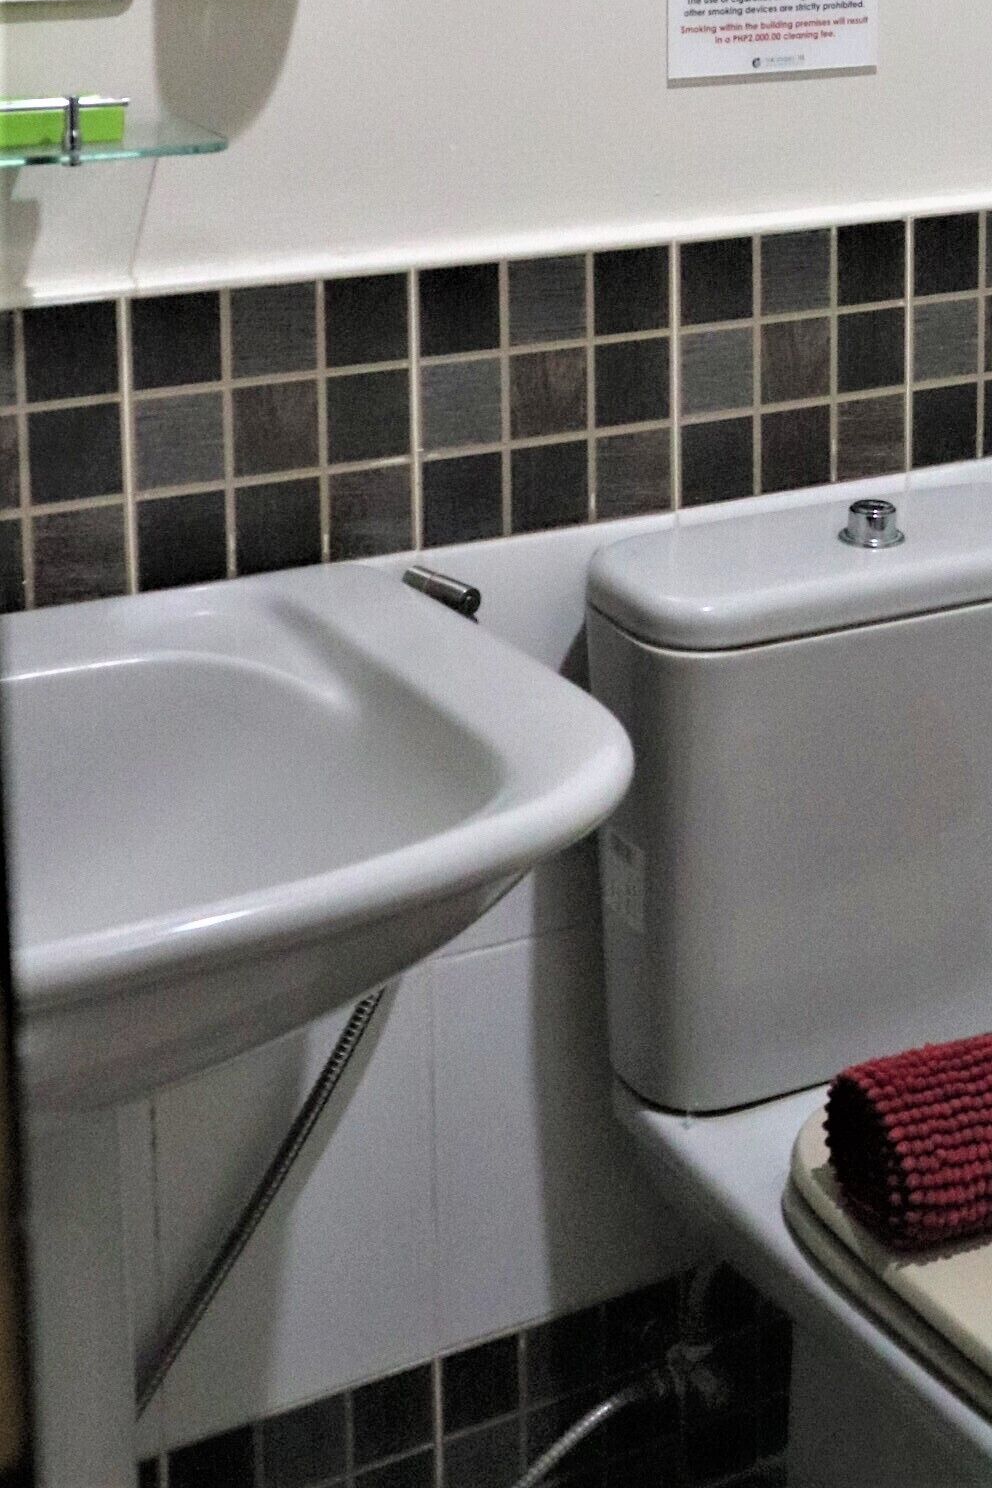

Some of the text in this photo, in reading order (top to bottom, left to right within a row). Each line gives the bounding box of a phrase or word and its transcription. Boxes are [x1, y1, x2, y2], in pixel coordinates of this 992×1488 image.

[684, 9, 705, 17] other
[708, 7, 743, 16] smoking
[745, 5, 777, 14] devices
[795, 2, 820, 12] strictly
[681, 25, 717, 34] Smoking
[719, 23, 743, 32] within
[760, 21, 793, 30] building
[795, 19, 830, 28] premises
[833, 16, 845, 25] will
[847, 16, 868, 25] result
[715, 36, 722, 44] in
[783, 31, 818, 40] cleaning
[820, 30, 835, 38] fee.
